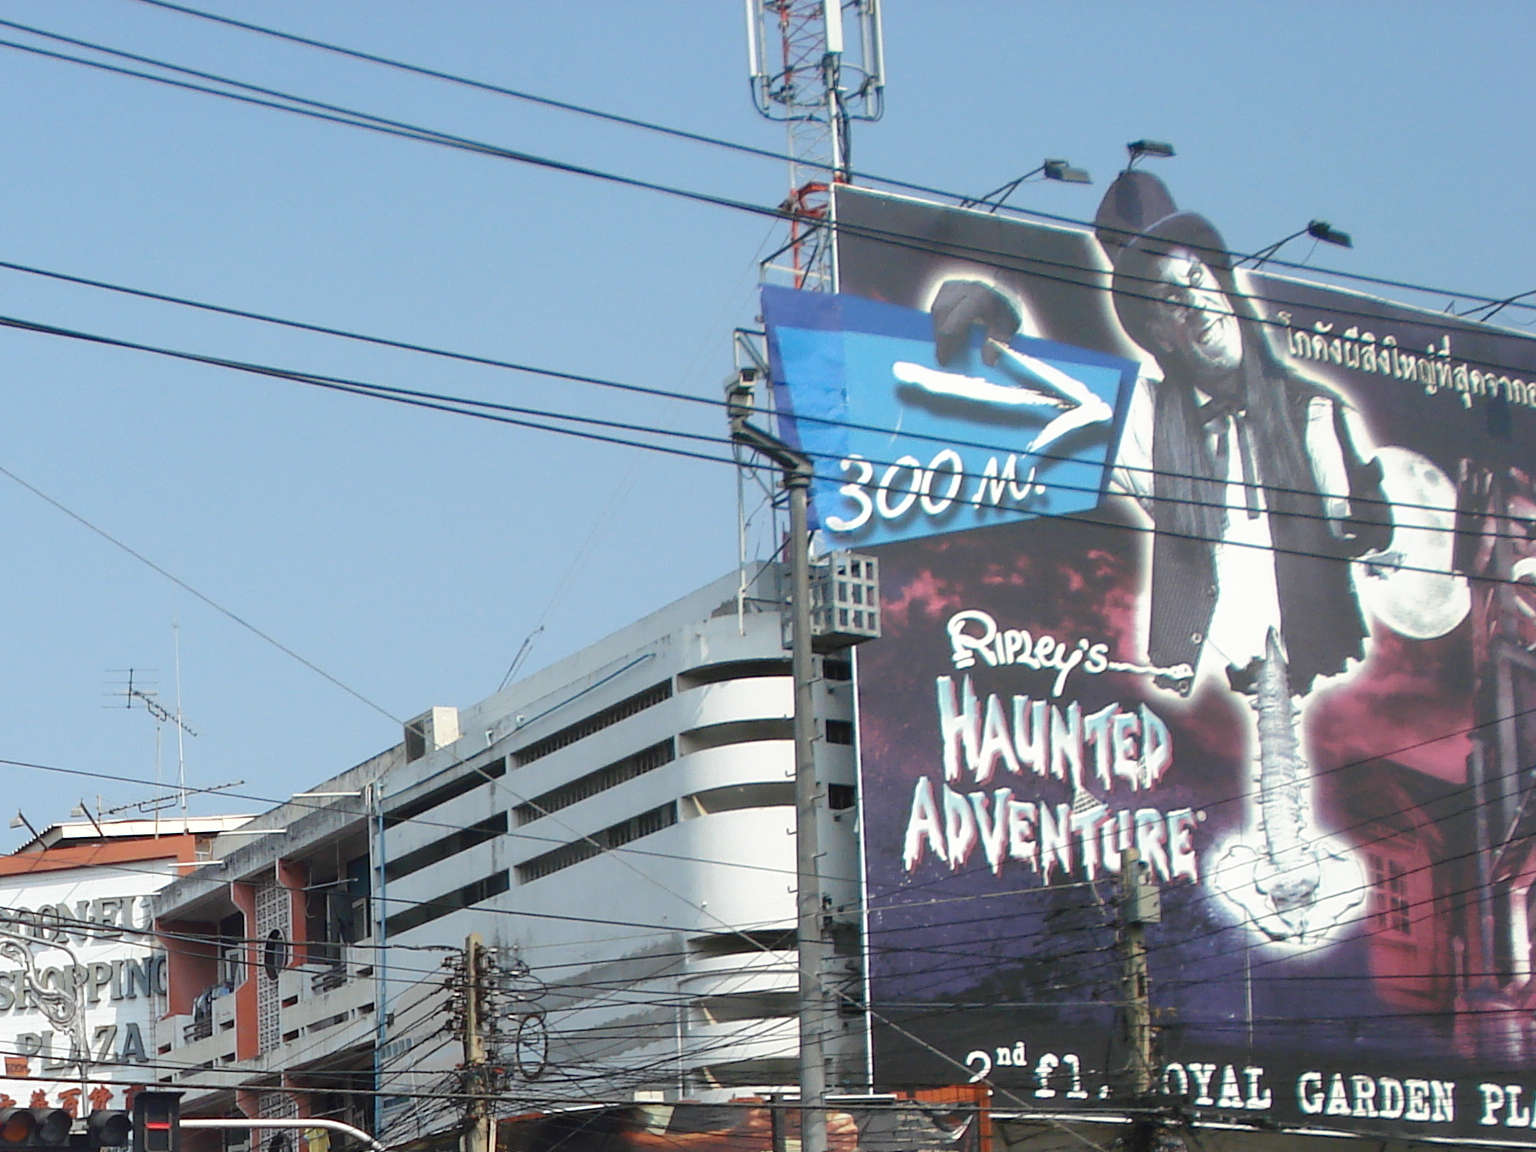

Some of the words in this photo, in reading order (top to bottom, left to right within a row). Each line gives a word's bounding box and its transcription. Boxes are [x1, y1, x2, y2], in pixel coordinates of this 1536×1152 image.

[825, 449, 963, 533] 300
[936, 673, 1173, 793] HAUNTED
[902, 776, 1199, 887] ADVENTURE
[16, 1022, 150, 1071] PLZA
[1161, 1061, 1273, 1111] OYAL
[1297, 1071, 1456, 1124] GARDEN
